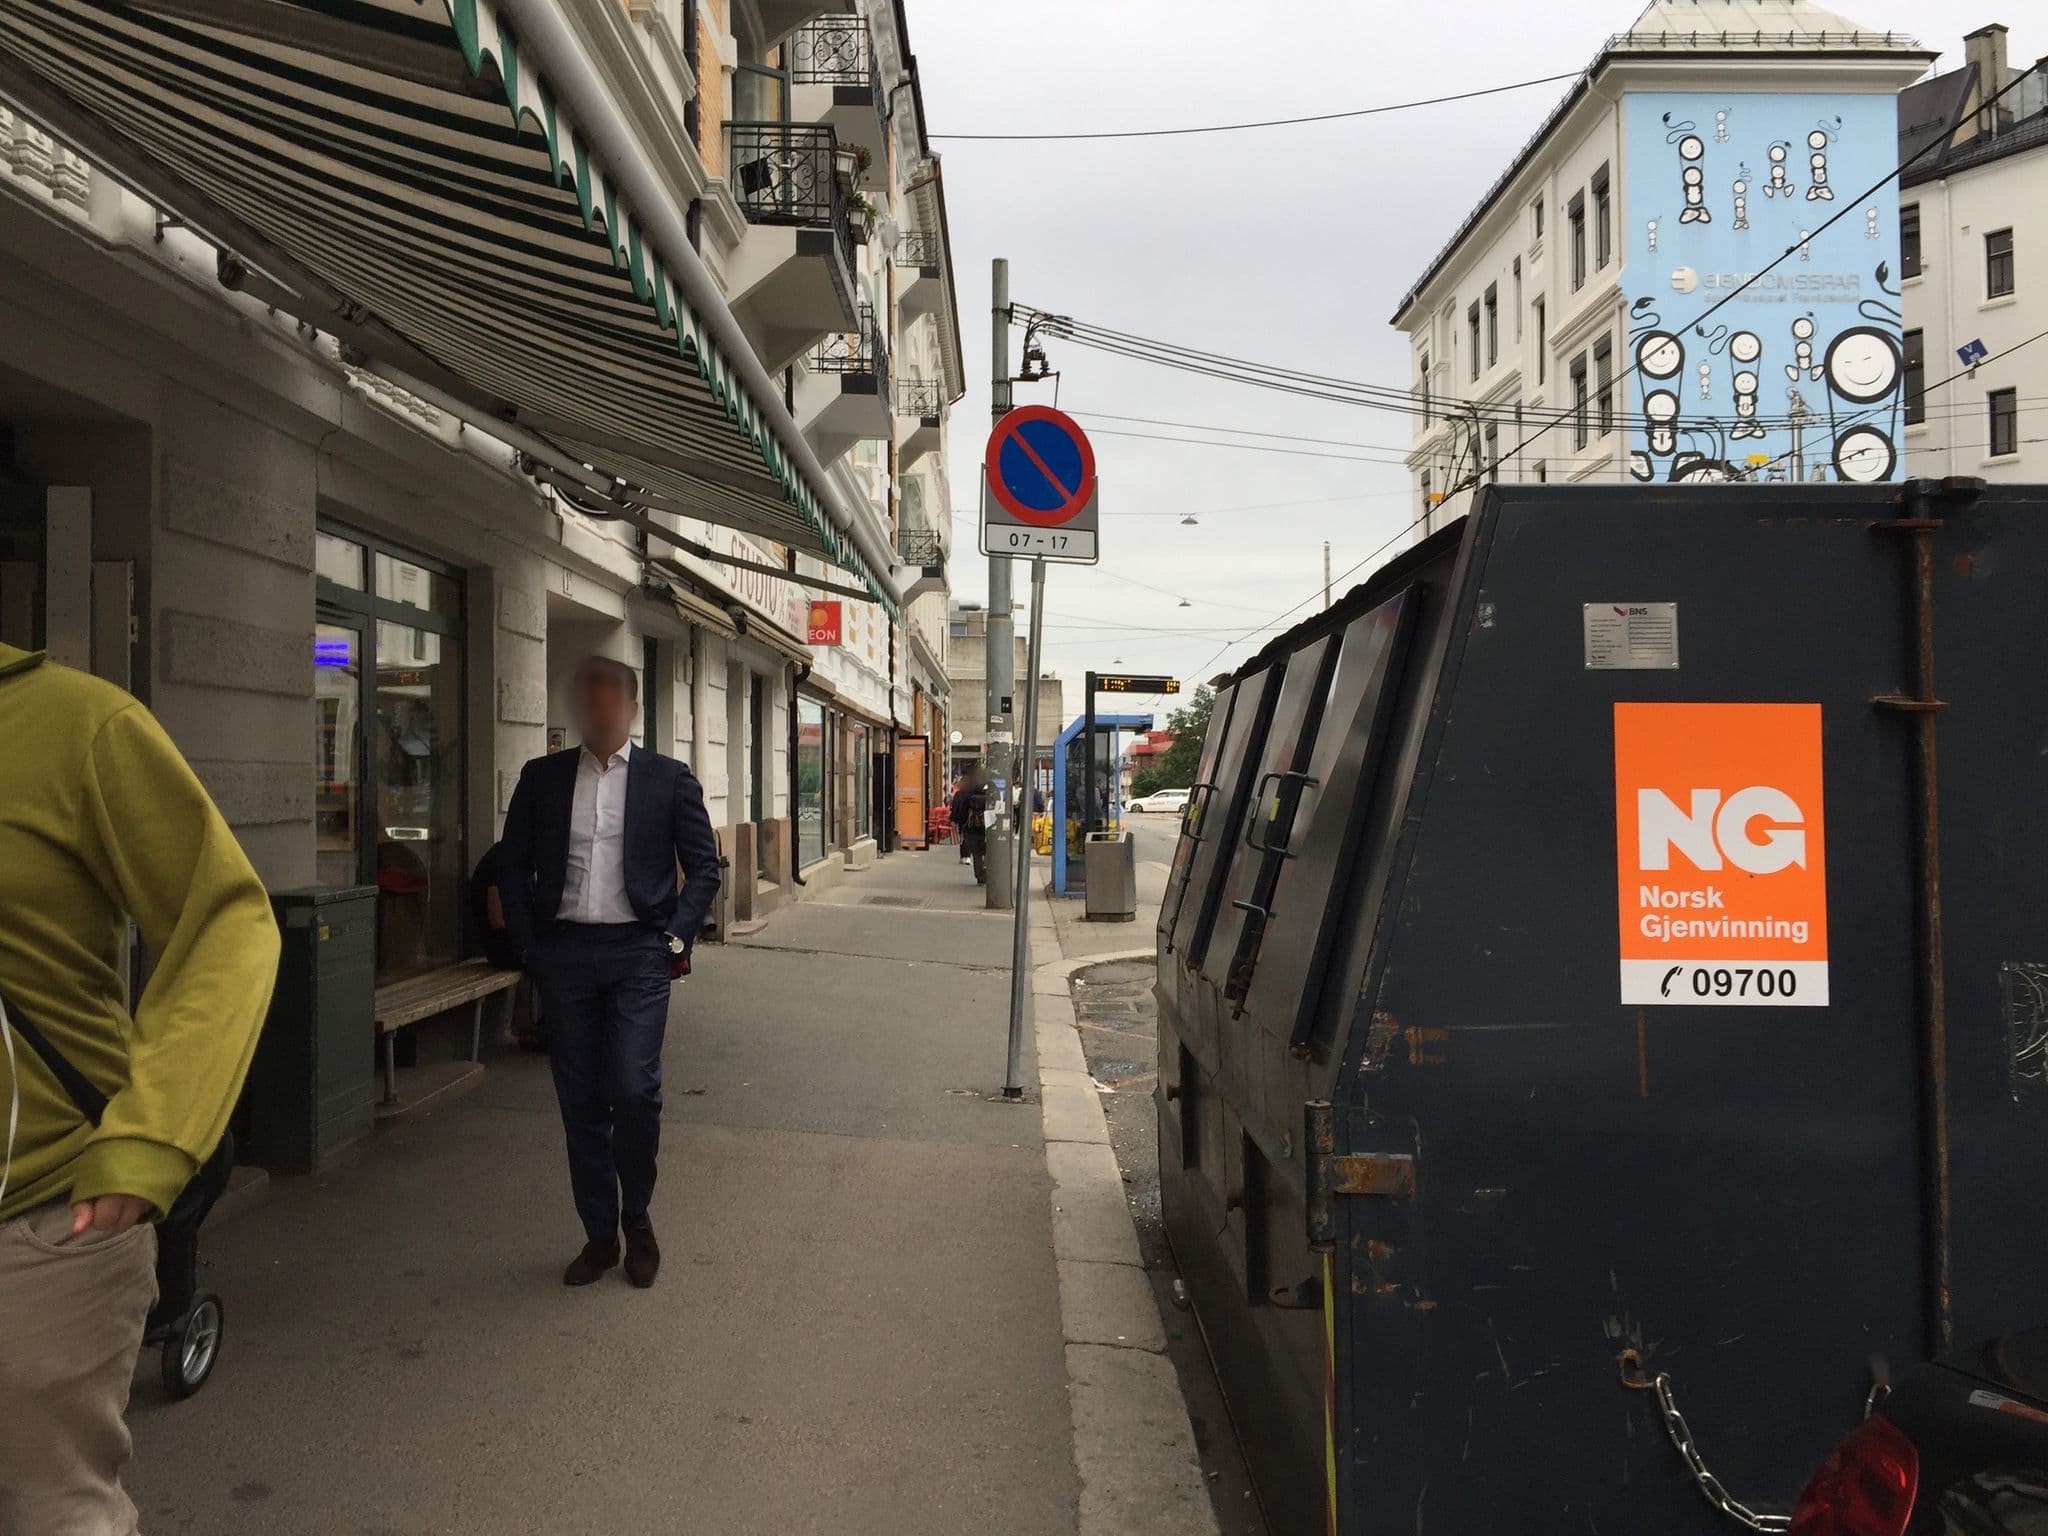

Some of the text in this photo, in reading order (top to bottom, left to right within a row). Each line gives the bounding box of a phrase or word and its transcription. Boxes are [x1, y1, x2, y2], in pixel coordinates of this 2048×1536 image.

[1629, 607, 1648, 615] BNS
[1637, 786, 1807, 875] NG
[1639, 885, 1725, 909] Norsk
[1640, 914, 1809, 944] Gjenvinning
[1692, 968, 1797, 998] 09700
